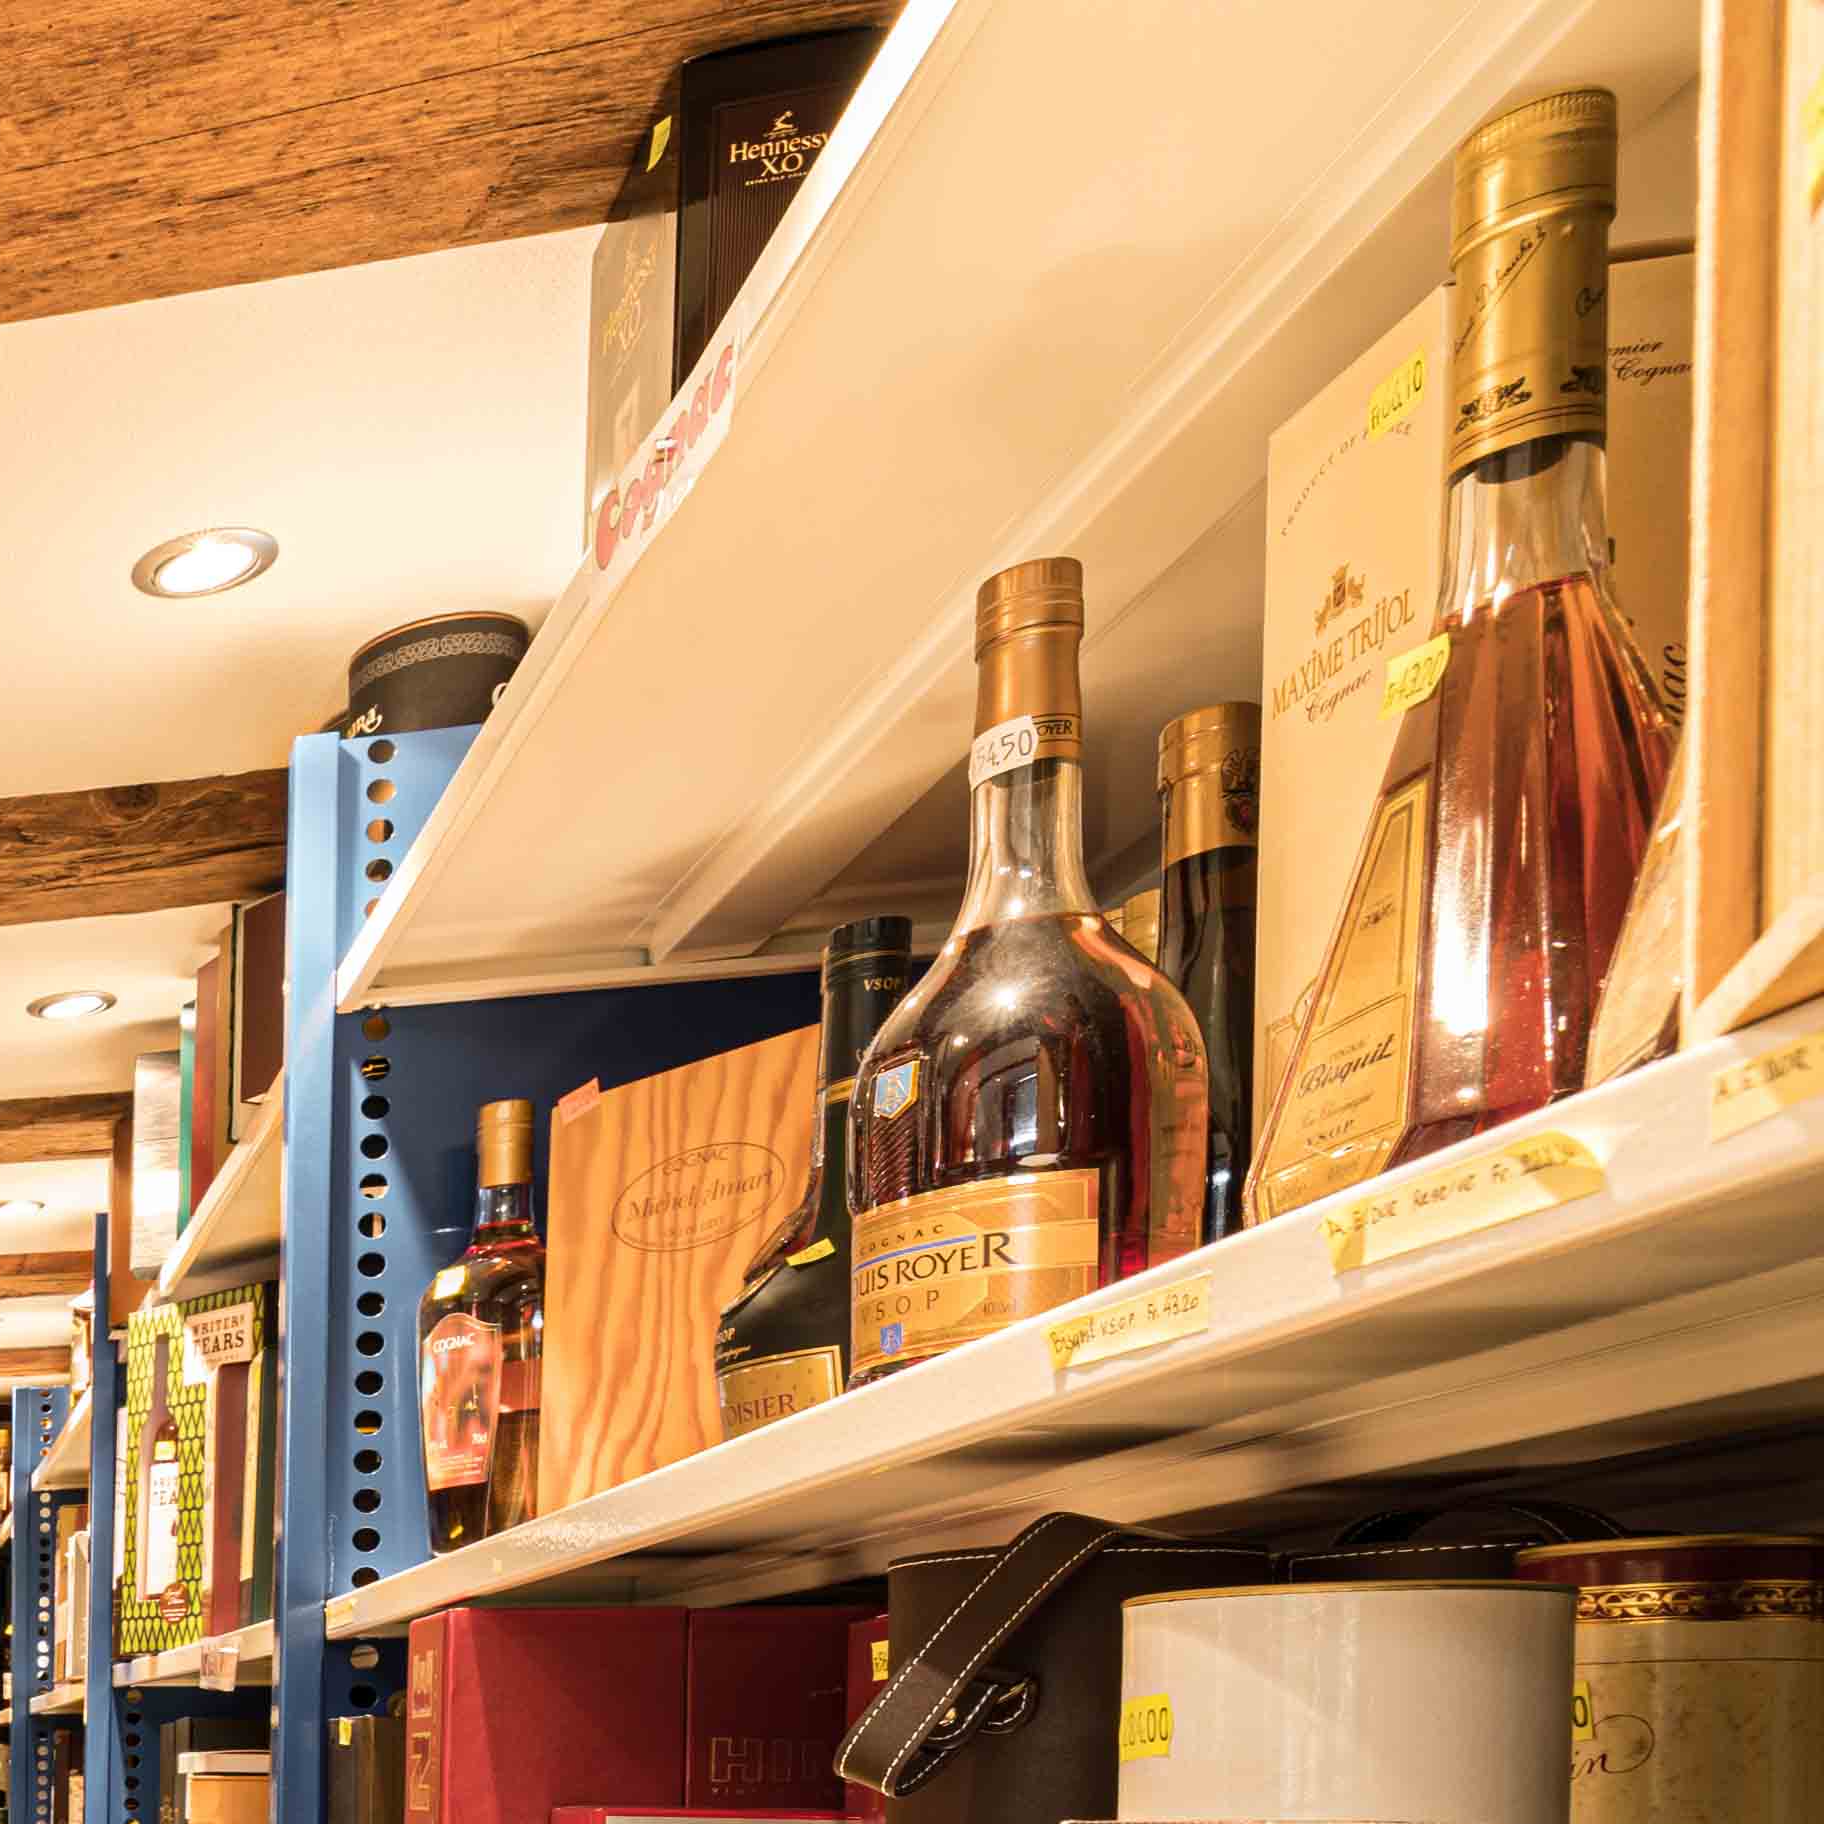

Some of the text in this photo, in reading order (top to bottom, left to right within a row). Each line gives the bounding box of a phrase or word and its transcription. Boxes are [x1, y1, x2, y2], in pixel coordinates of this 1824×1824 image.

[729, 132, 829, 163] Hennessy
[761, 152, 804, 177] XO
[893, 1231, 1017, 1288] ROYER
